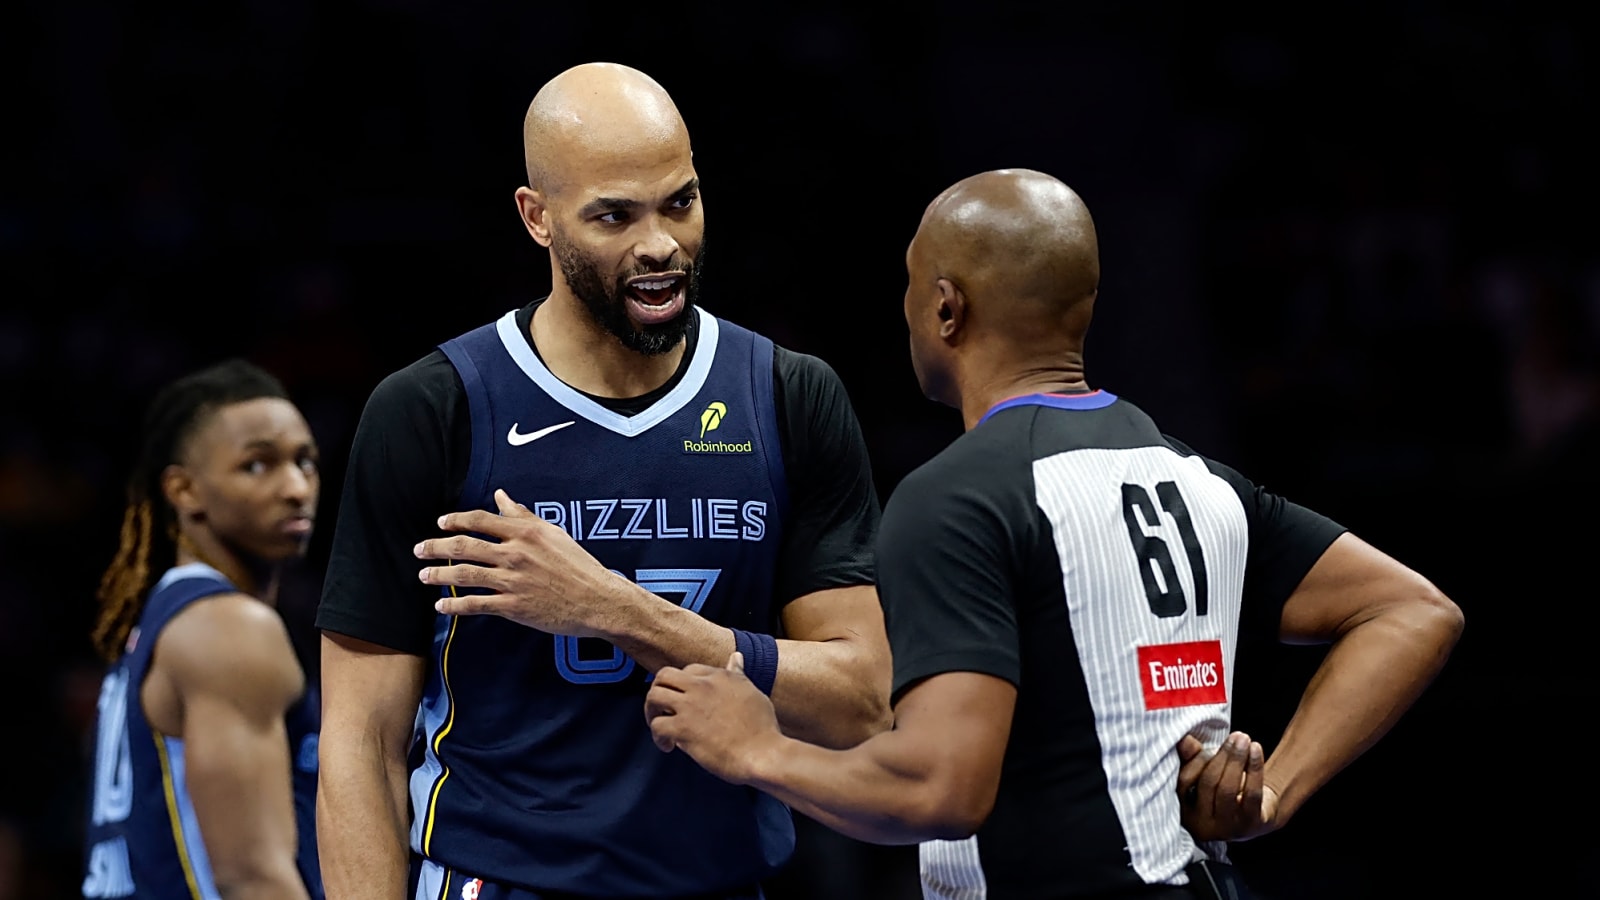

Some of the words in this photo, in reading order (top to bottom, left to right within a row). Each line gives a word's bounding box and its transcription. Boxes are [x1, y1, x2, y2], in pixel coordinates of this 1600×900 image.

[684, 440, 752, 453] Robinhood
[533, 498, 767, 541] RIZZLIES
[1121, 480, 1209, 619] 61
[1148, 658, 1218, 692] Emirates
